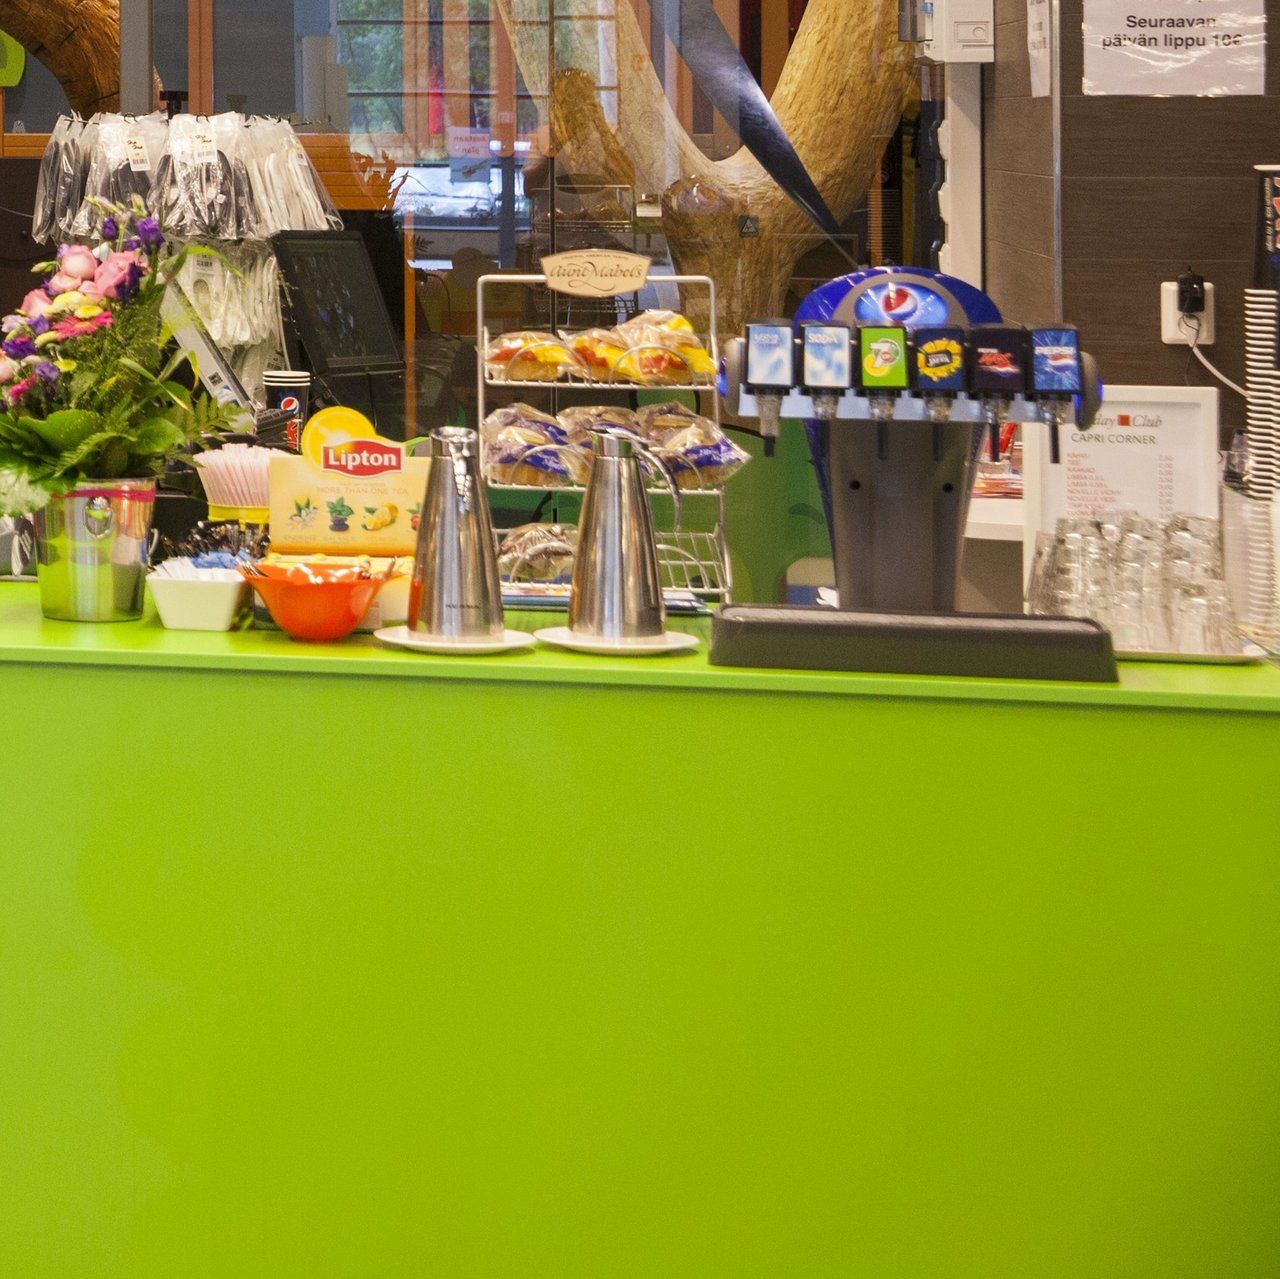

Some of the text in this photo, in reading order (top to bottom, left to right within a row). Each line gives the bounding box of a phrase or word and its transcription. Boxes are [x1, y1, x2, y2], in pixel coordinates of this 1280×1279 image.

[1125, 14, 1217, 28] Seuraavan
[1102, 33, 1158, 50] päivän
[1163, 33, 1206, 50] lippu
[807, 333, 838, 344] SODA
[1132, 414, 1163, 428] Club
[1071, 432, 1157, 445] CAPRI CORNER
[328, 448, 397, 470] Lipton
[317, 487, 409, 496] MORE THAN ONE TEA
